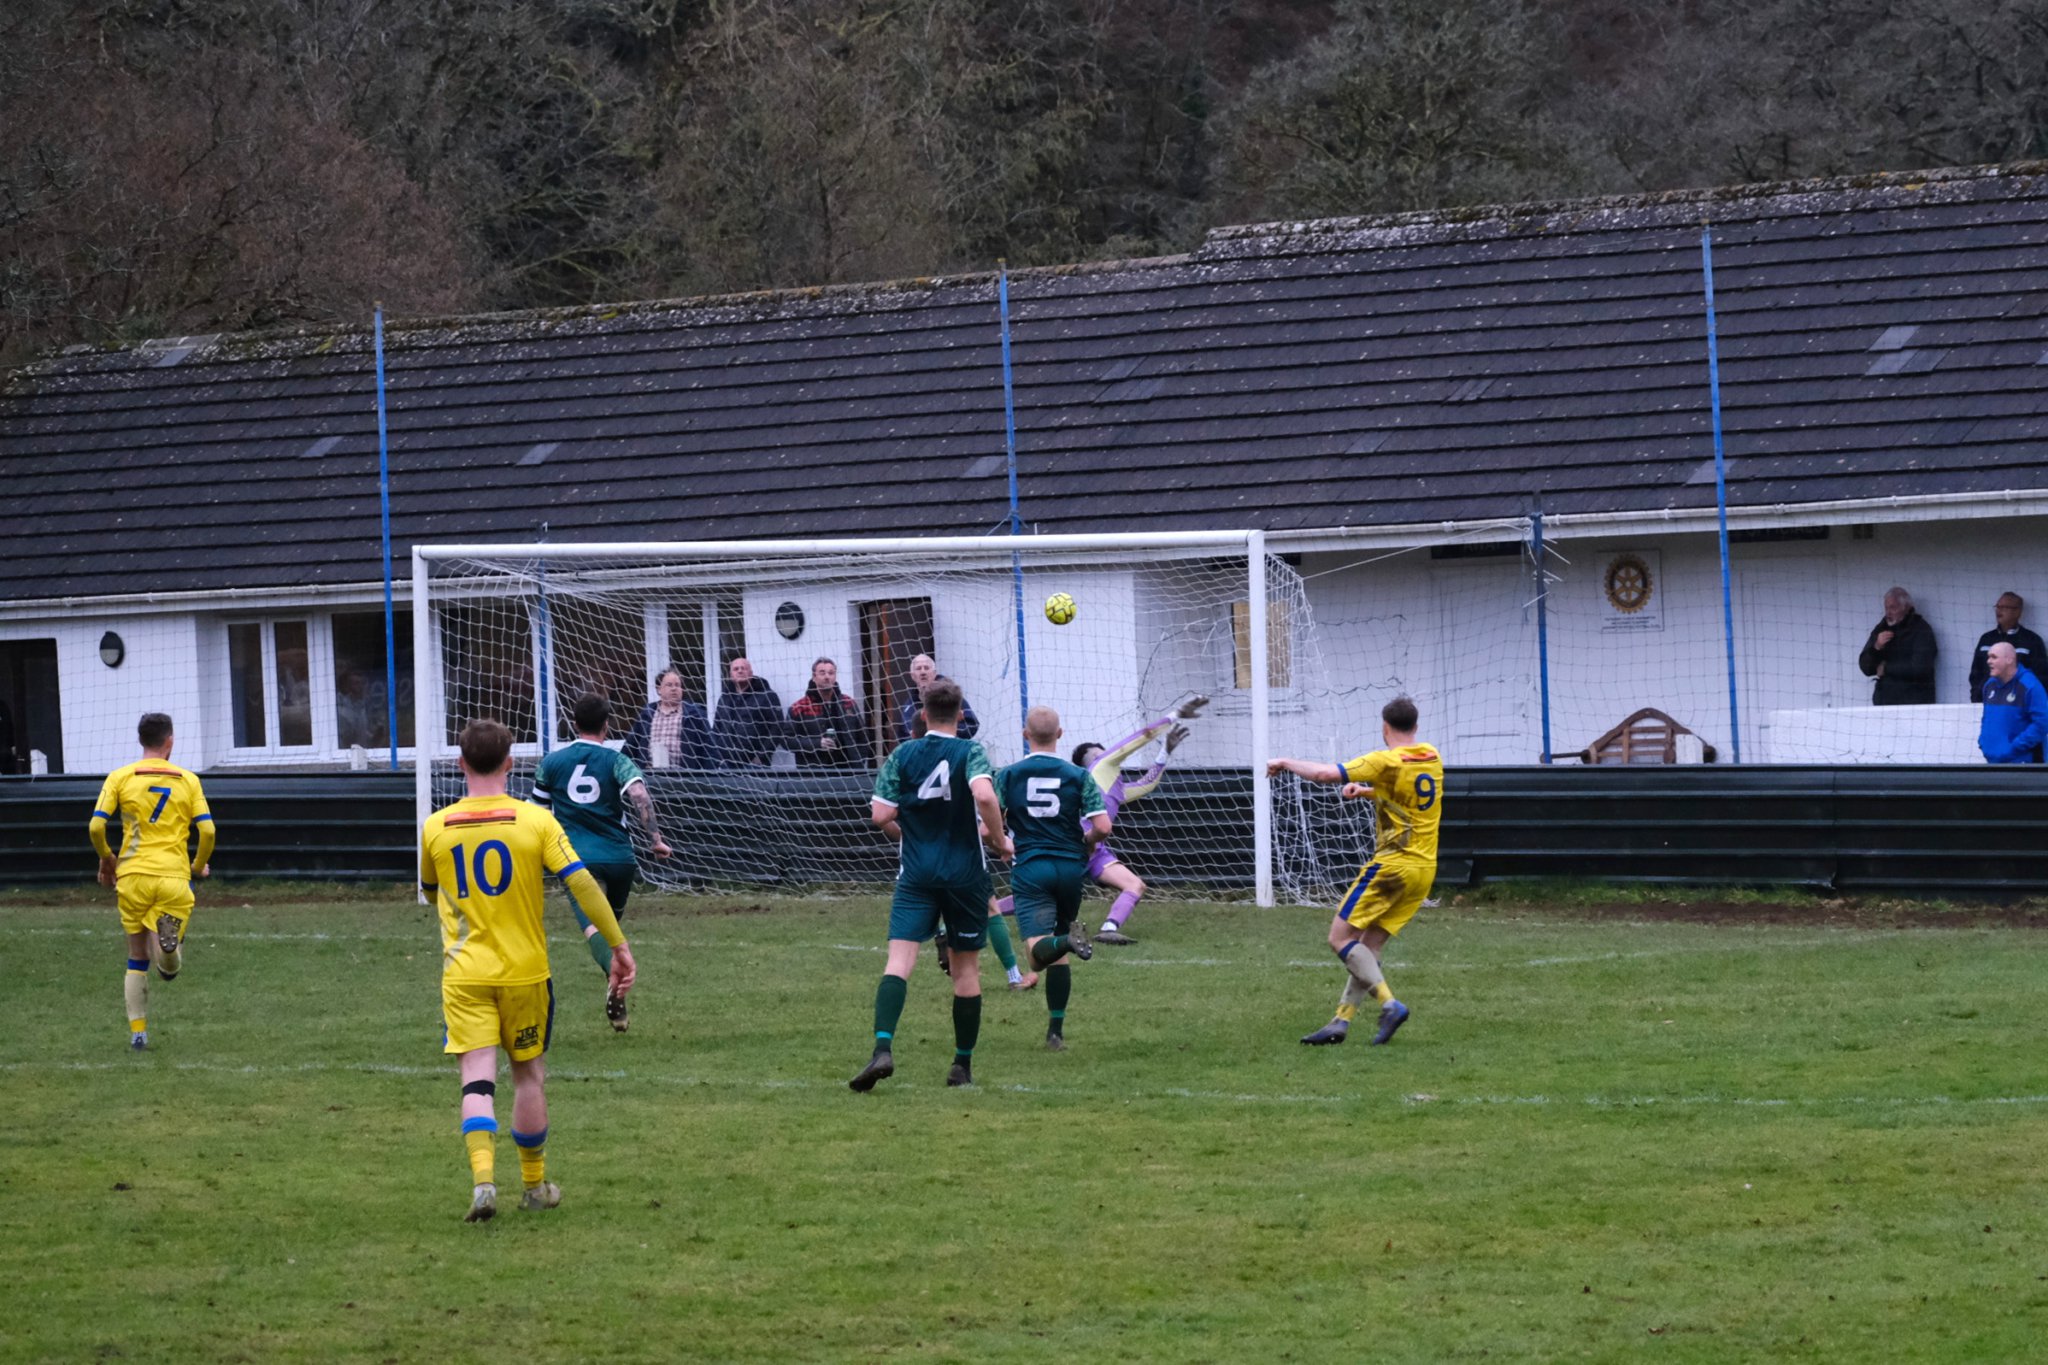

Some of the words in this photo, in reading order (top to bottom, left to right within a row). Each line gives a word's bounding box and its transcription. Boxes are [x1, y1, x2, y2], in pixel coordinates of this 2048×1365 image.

[567, 763, 601, 804] 6
[917, 759, 951, 801] 4
[1026, 776, 1061, 818] 5
[1415, 773, 1436, 812] 9
[148, 786, 172, 823] 7
[450, 839, 514, 899] 10
